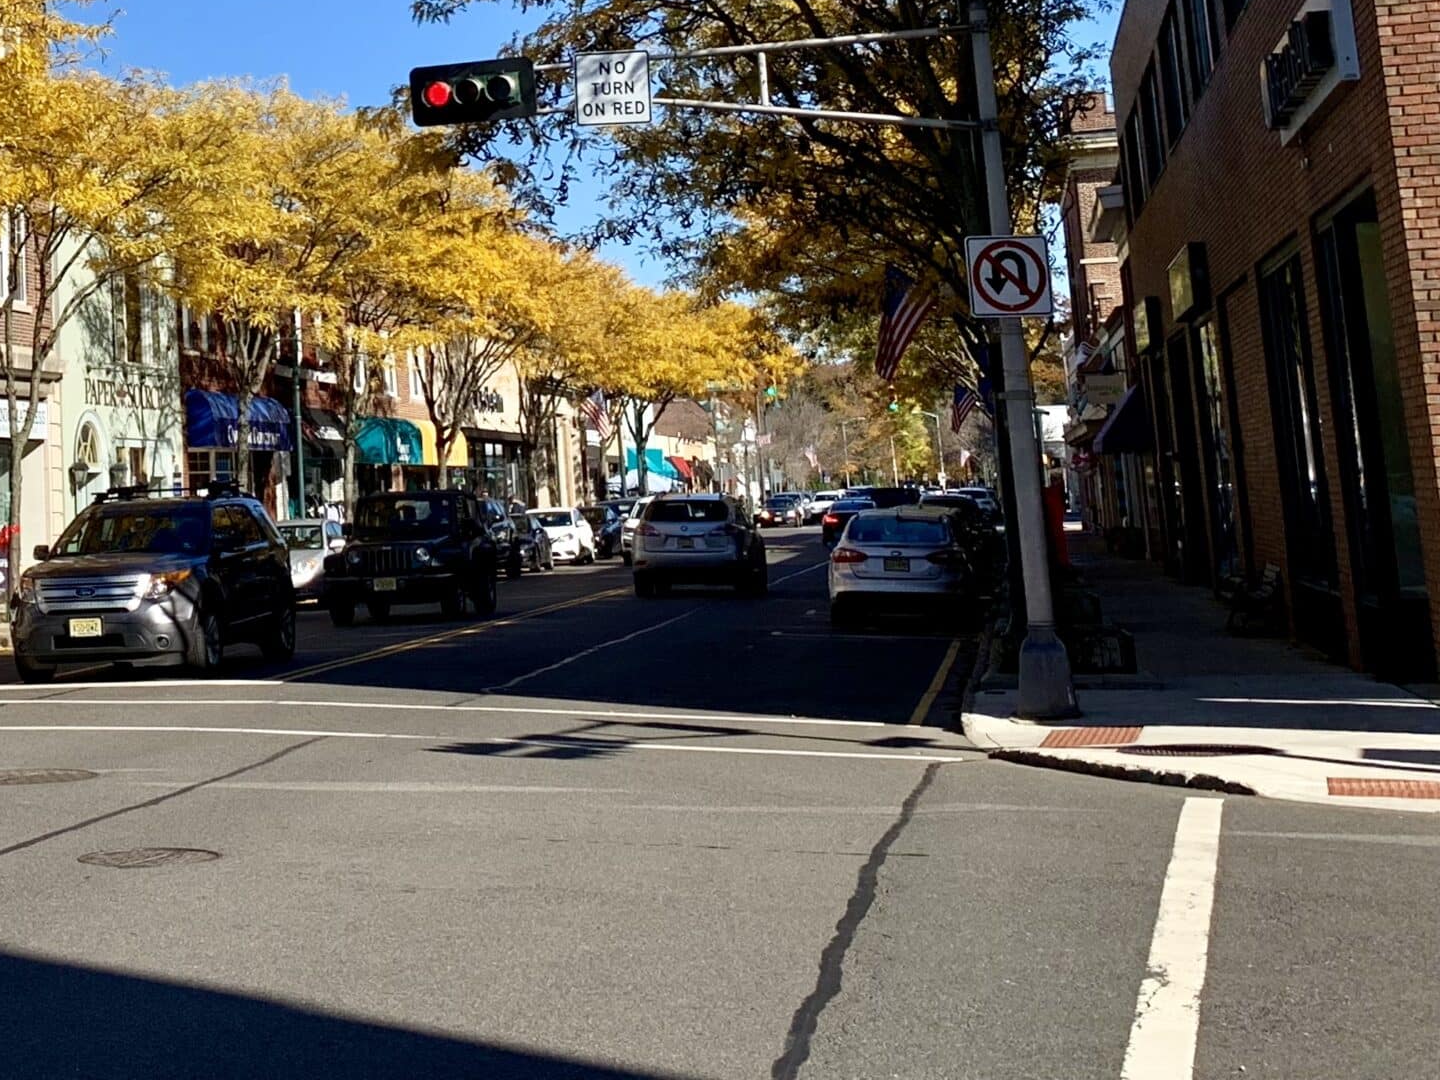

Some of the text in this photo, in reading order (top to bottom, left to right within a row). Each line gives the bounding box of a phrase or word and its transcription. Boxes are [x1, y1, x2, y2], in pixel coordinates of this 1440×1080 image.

[599, 61, 626, 75] NO
[592, 81, 635, 96] TURN
[583, 101, 645, 117] ON RED
[85, 377, 117, 407] PAPER
